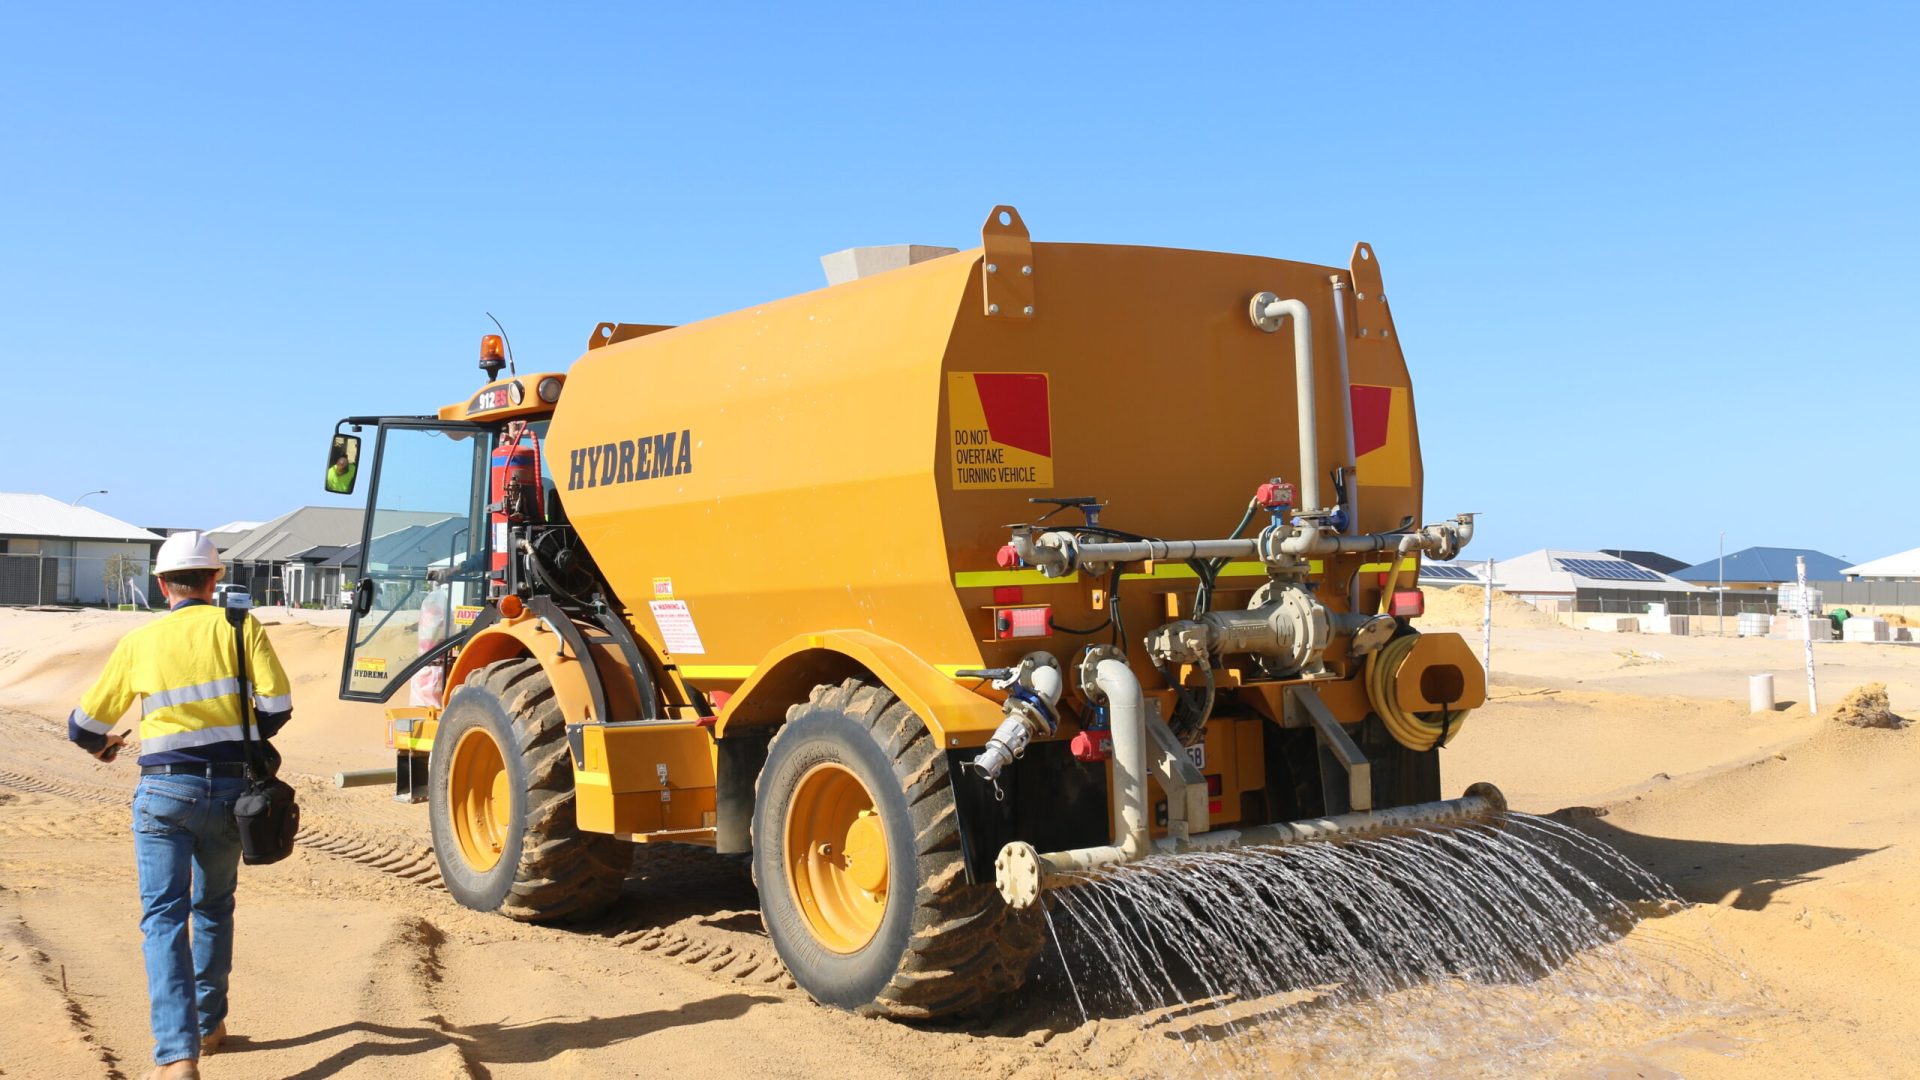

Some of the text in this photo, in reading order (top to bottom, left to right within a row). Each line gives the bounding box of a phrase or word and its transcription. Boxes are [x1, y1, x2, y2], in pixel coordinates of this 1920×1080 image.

[480, 390, 507, 409] 912ES
[955, 430, 988, 445] DO NOT
[568, 429, 692, 491] HYDREMA
[956, 449, 1004, 464] OVERTAKE
[957, 467, 1036, 483] TURNING VEHICLE
[354, 669, 388, 679] HYDREMA
